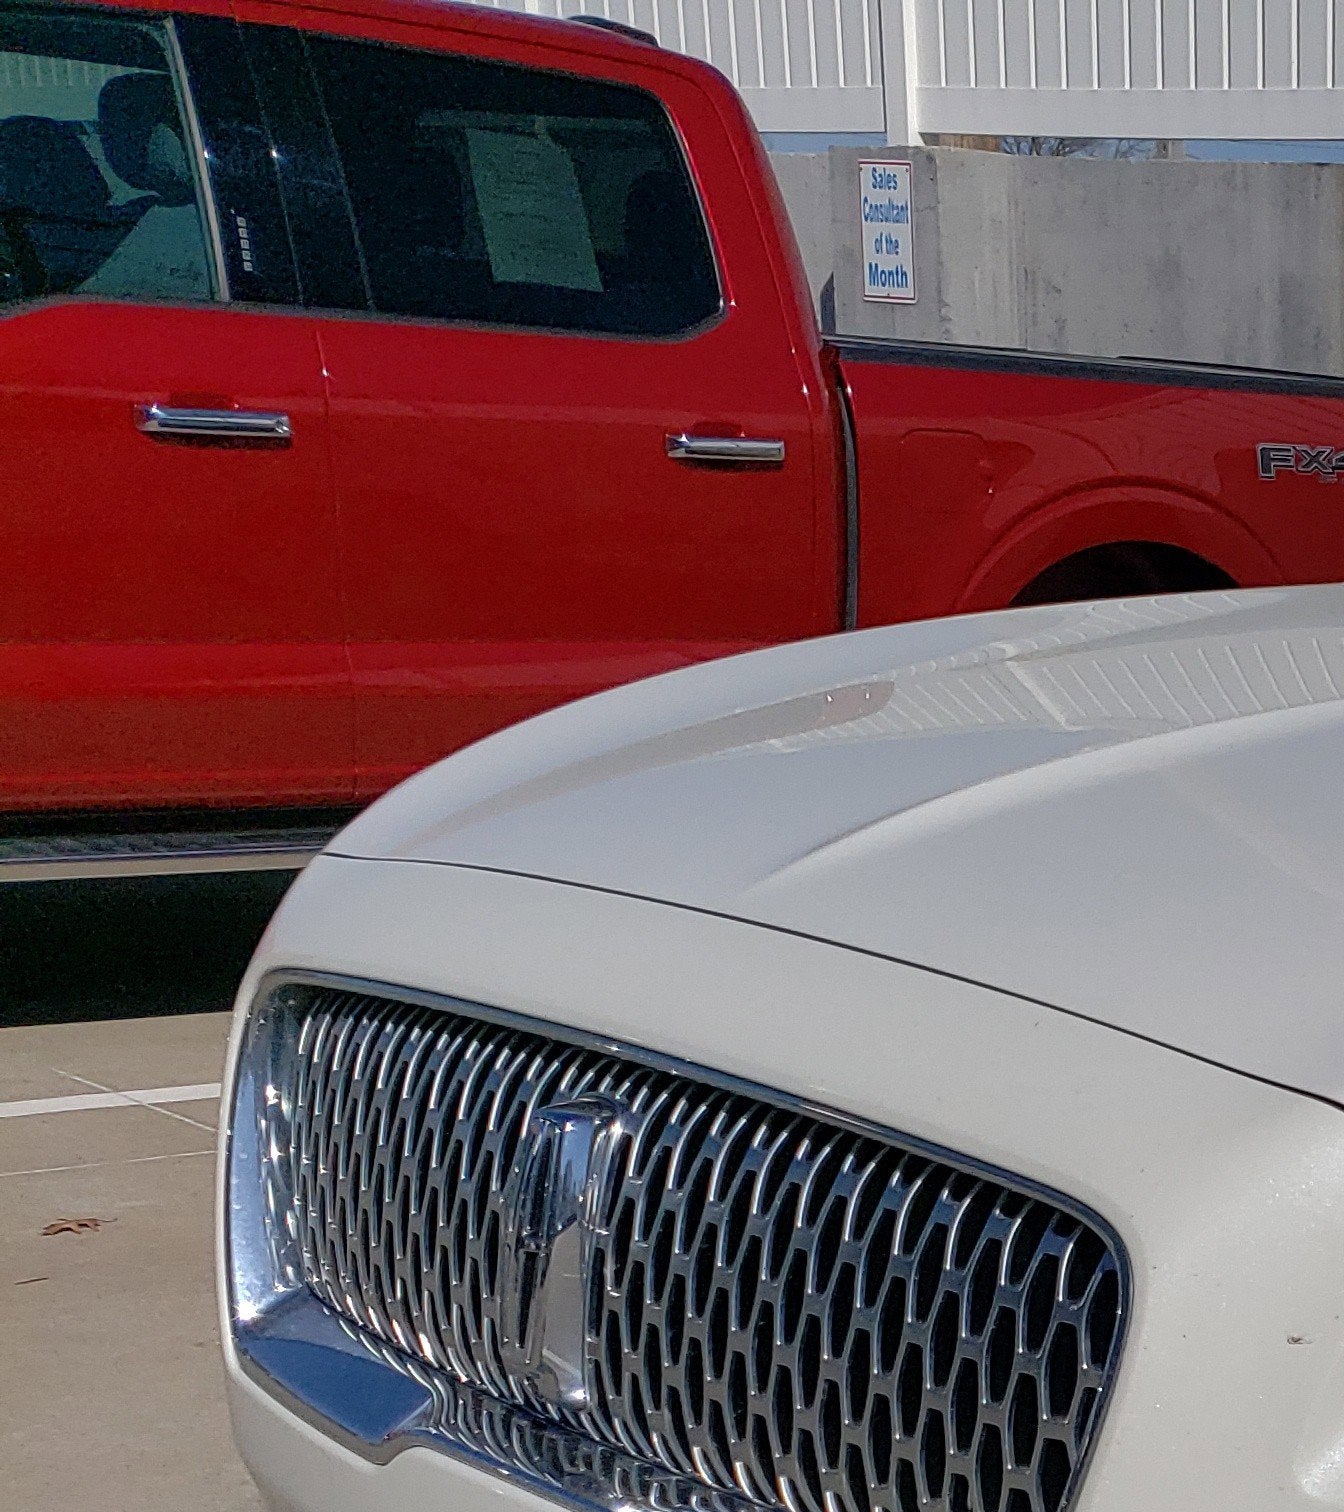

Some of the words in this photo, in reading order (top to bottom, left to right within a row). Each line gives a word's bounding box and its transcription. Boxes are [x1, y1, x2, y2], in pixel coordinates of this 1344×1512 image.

[871, 167, 898, 191] Sales
[863, 196, 909, 224] Consultant
[874, 231, 883, 255] of
[885, 232, 899, 256] the
[868, 262, 909, 288] Month
